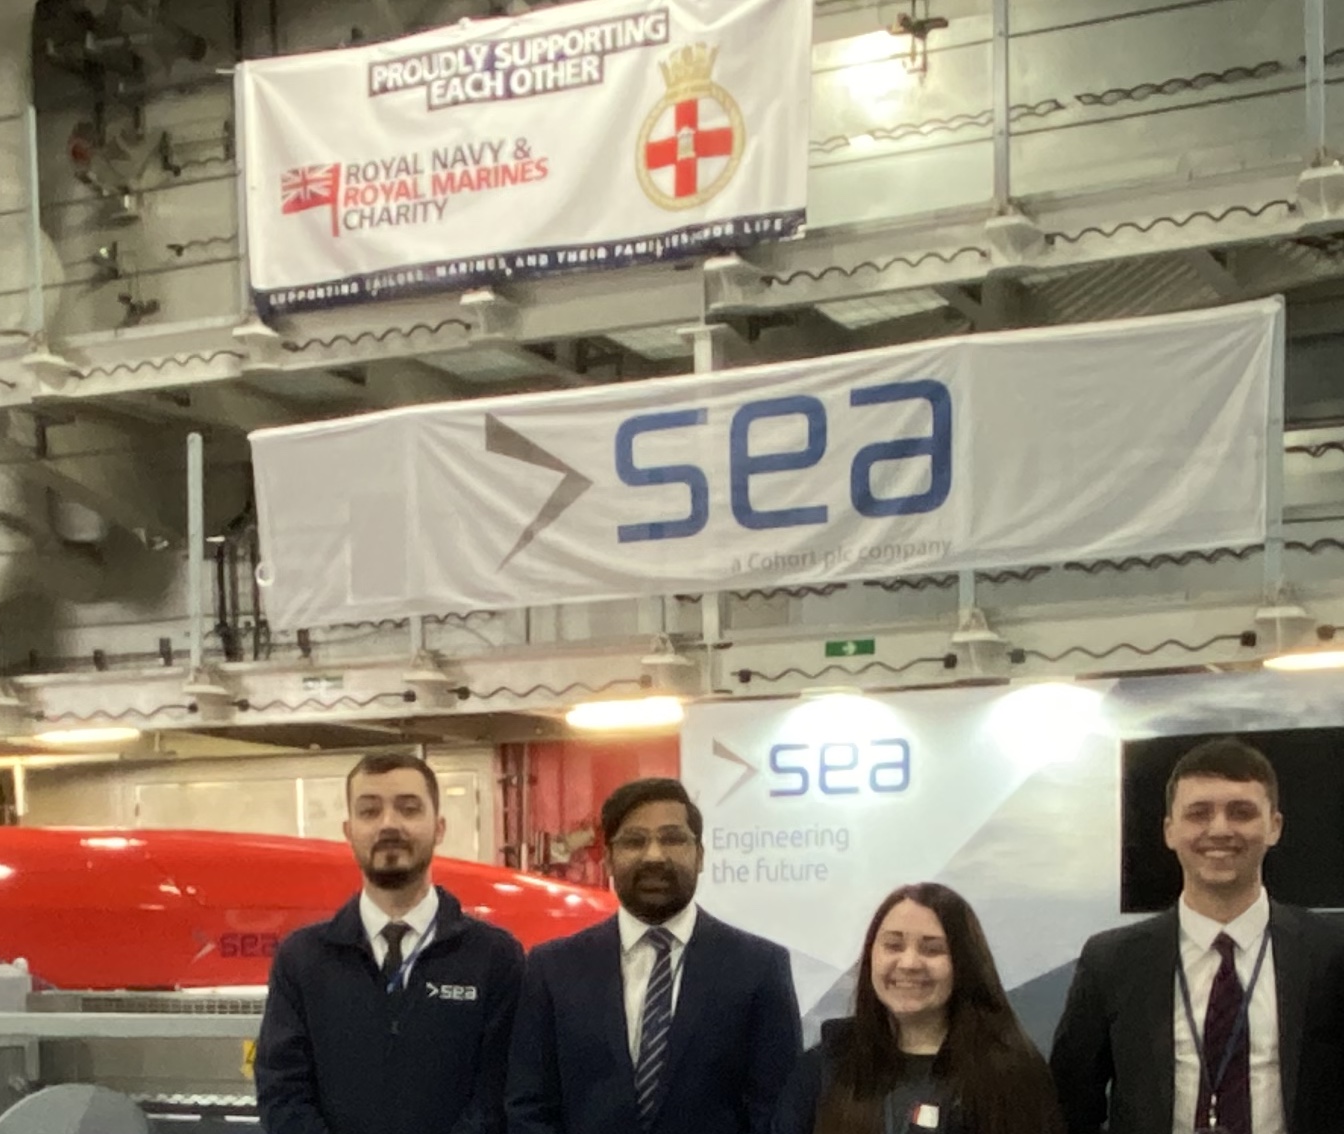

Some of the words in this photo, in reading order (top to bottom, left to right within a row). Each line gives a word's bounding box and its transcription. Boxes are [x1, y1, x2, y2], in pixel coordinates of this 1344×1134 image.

[371, 43, 489, 92] PROUDLY
[494, 13, 667, 67] SUPPORTING
[429, 70, 504, 106] EACH
[509, 54, 601, 96] OTHER
[343, 175, 425, 208] ROYAL
[431, 157, 549, 198] MARINES
[345, 152, 424, 185] ROYAL
[431, 139, 505, 171] NAVY
[513, 136, 532, 161] &
[343, 198, 448, 231] CHARITY
[515, 253, 549, 268] AND
[557, 246, 606, 263] THEIR
[743, 217, 783, 235] LIFE
[614, 378, 953, 543] sea
[731, 557, 741, 573] a
[747, 549, 818, 572] Cohort
[823, 546, 852, 568] plc
[857, 539, 952, 561] company
[769, 737, 911, 797] sea
[712, 824, 850, 854] Engineering
[712, 859, 750, 884] the
[756, 857, 828, 883] future
[439, 984, 476, 1001] sea
